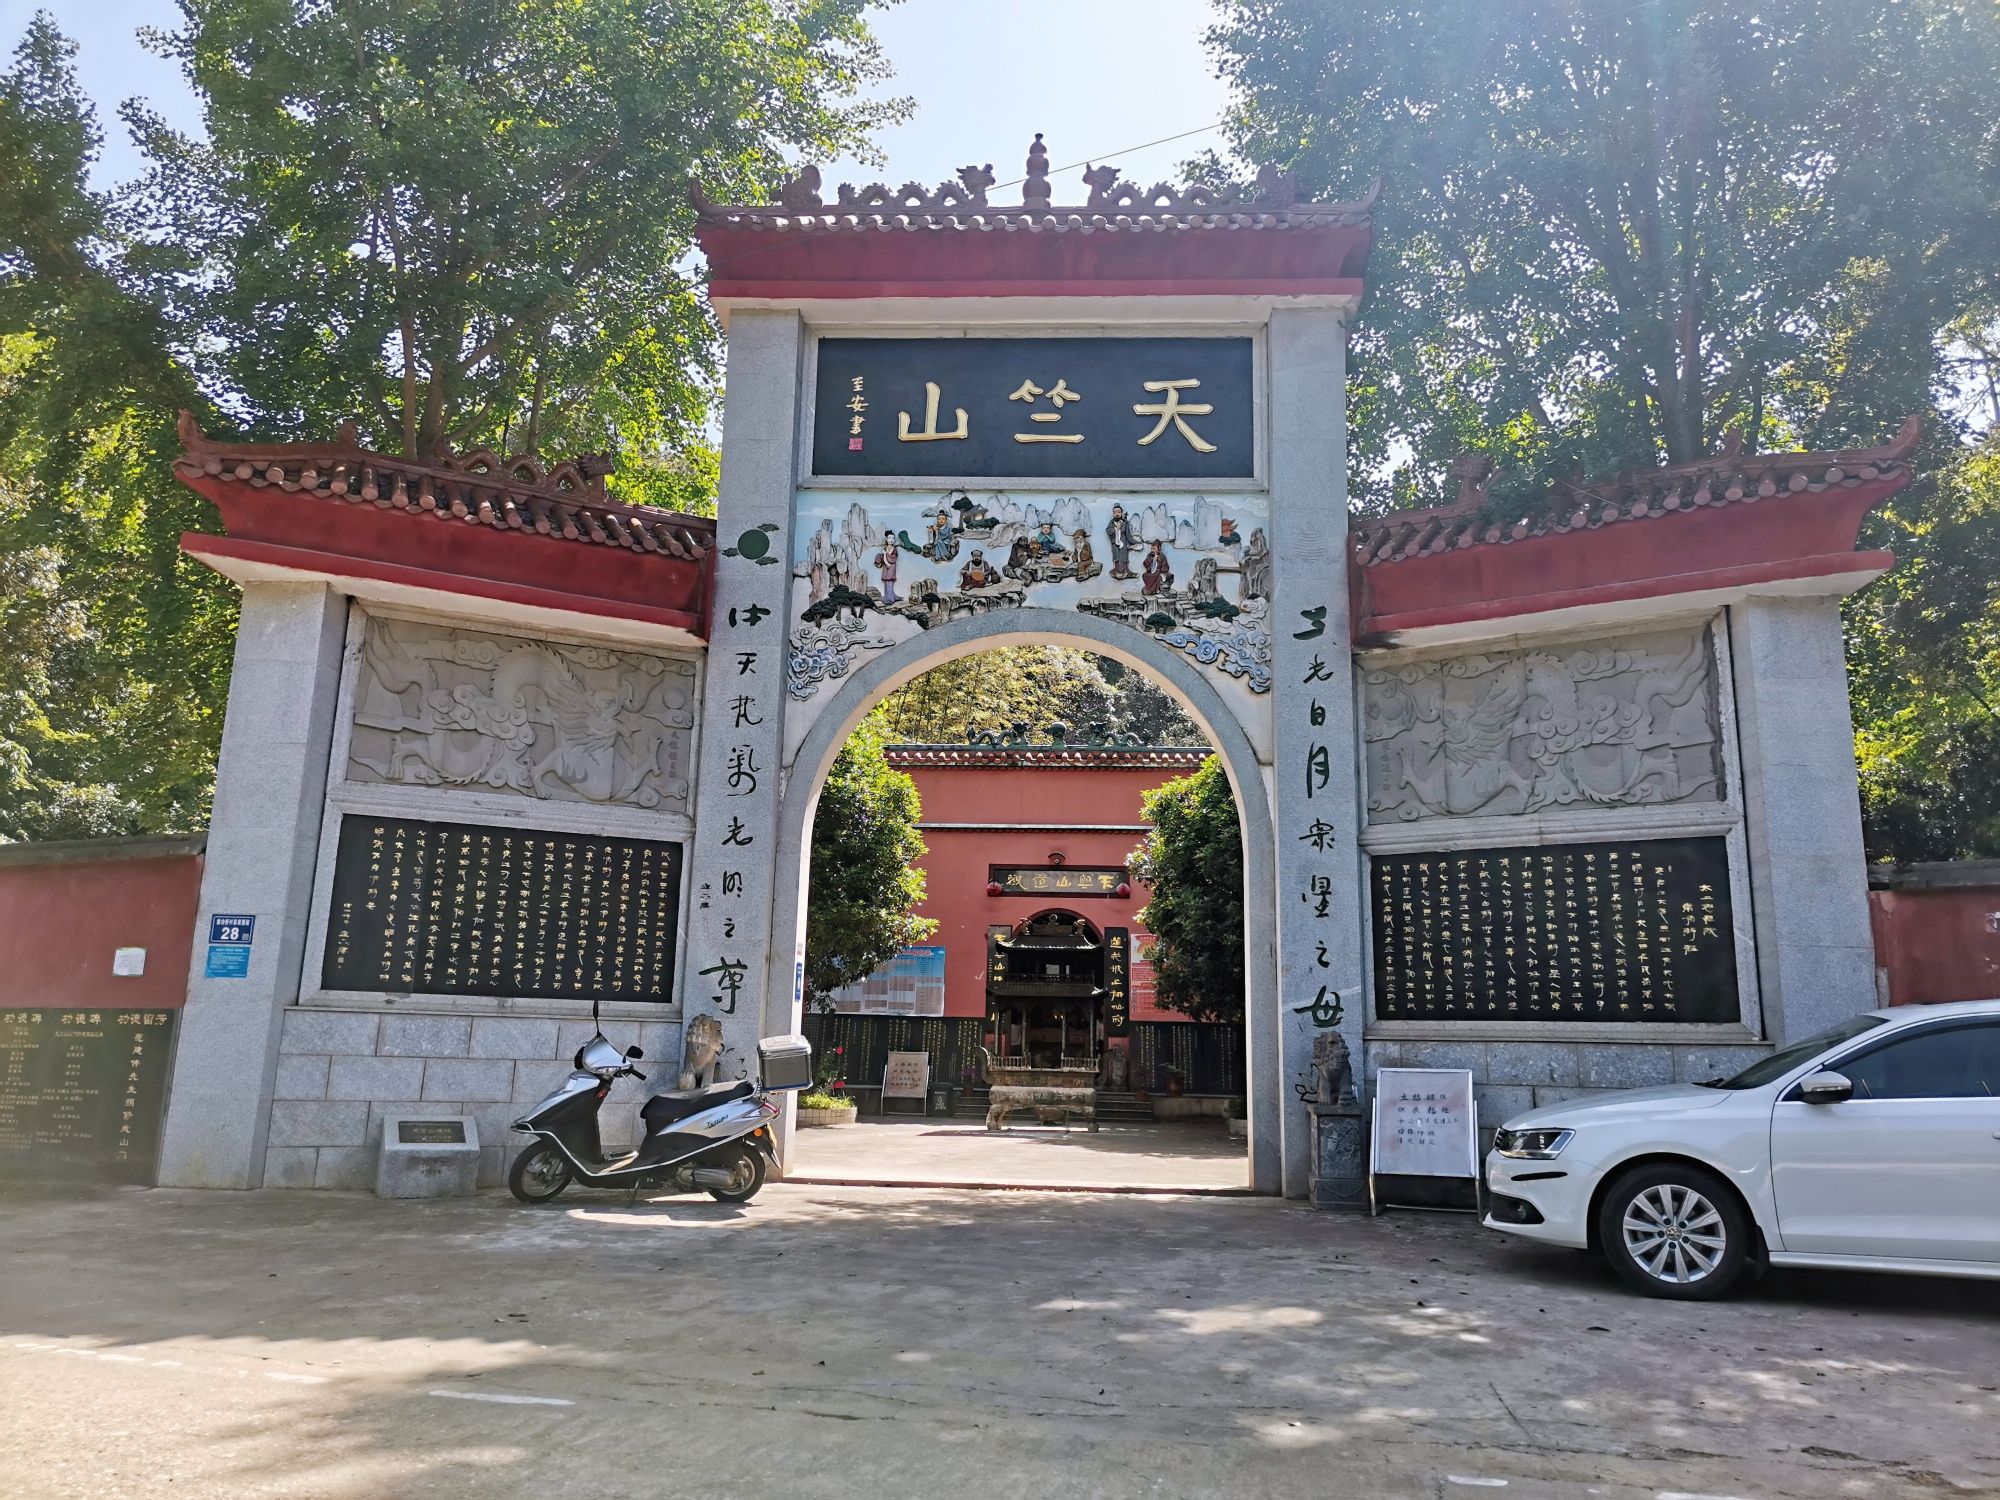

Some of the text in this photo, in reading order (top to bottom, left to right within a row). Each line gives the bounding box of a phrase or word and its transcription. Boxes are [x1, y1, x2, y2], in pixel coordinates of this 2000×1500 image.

[898, 378, 1217, 453] 天竺山
[220, 927, 239, 940] 28
